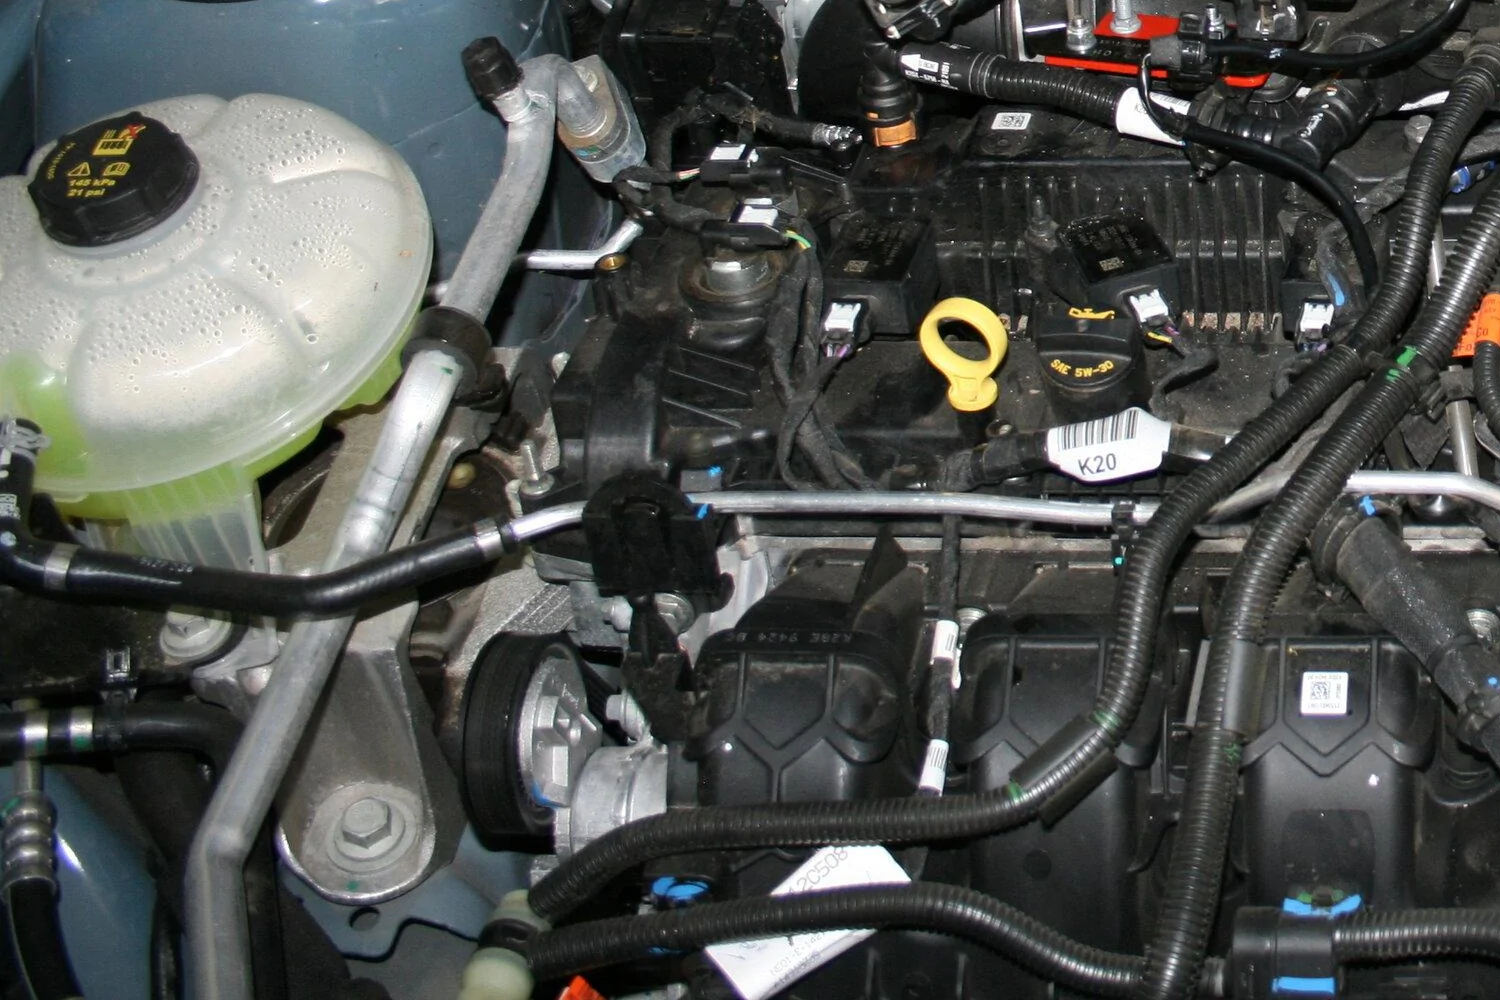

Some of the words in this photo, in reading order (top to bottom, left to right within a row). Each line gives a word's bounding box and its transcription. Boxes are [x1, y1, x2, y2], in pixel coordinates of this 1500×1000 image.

[1050, 359, 1071, 375] SAE
[1074, 360, 1115, 378] 5W-30
[1078, 453, 1117, 476] K20
